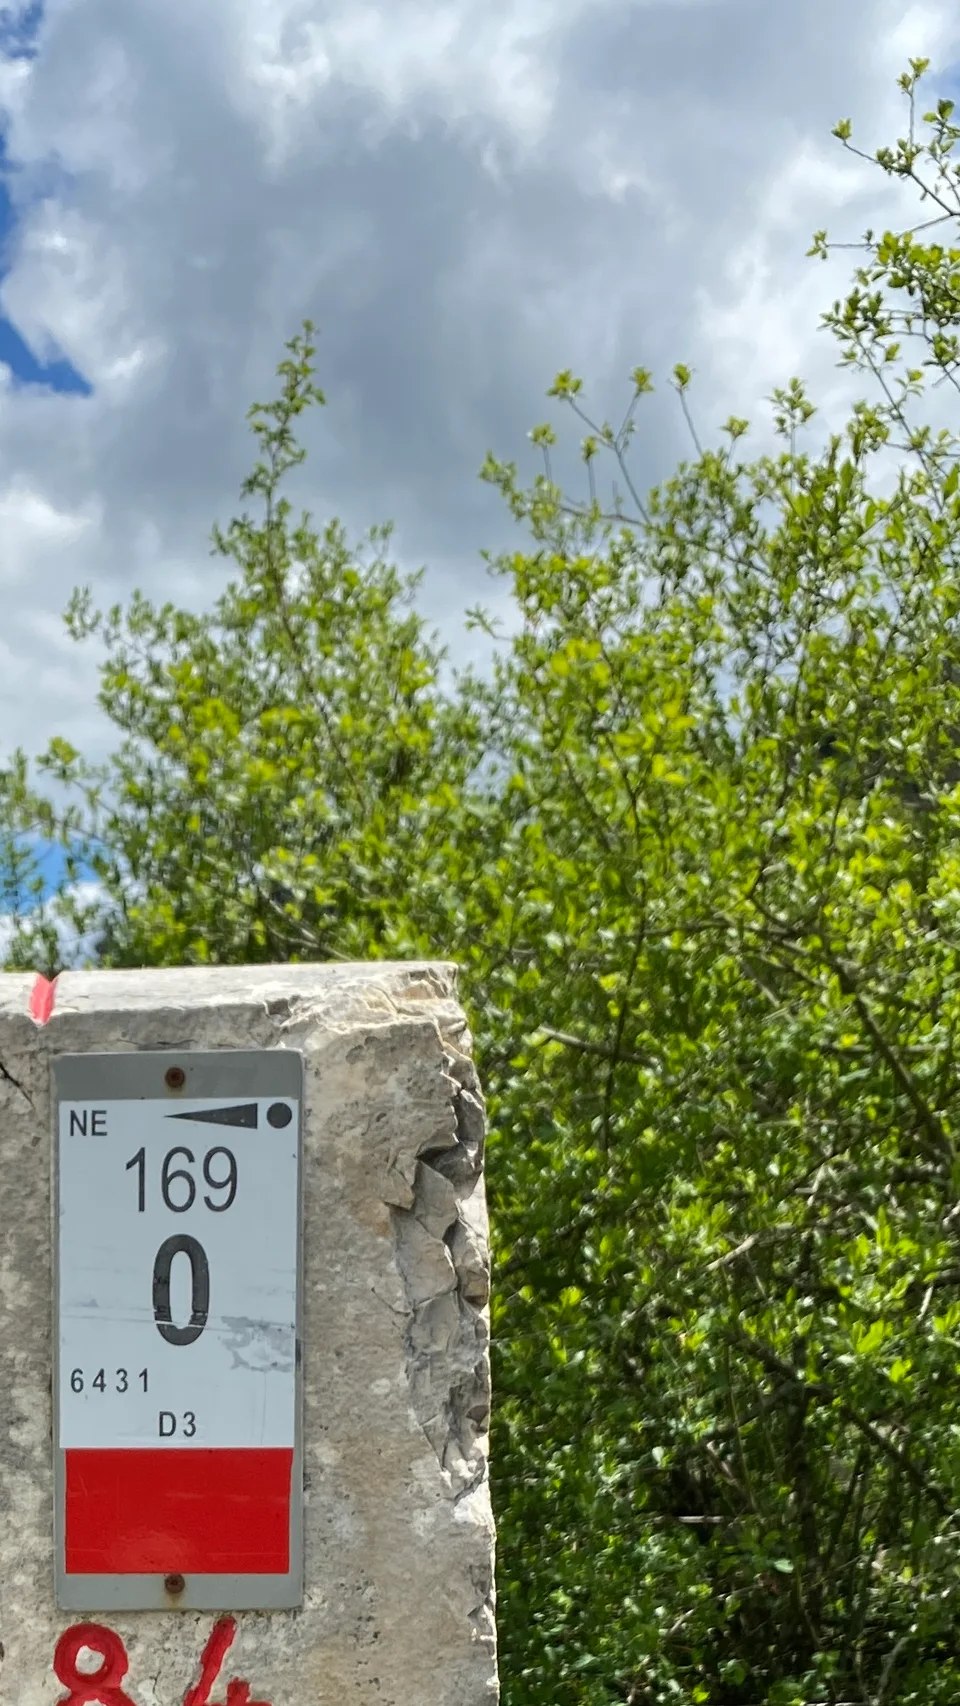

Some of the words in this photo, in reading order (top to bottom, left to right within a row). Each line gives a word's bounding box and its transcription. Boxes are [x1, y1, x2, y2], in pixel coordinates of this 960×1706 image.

[69, 1109, 108, 1137] NE
[125, 1146, 238, 1213] 169
[151, 1233, 211, 1347] 0
[69, 1367, 150, 1394] 6431
[157, 1411, 198, 1438] D3
